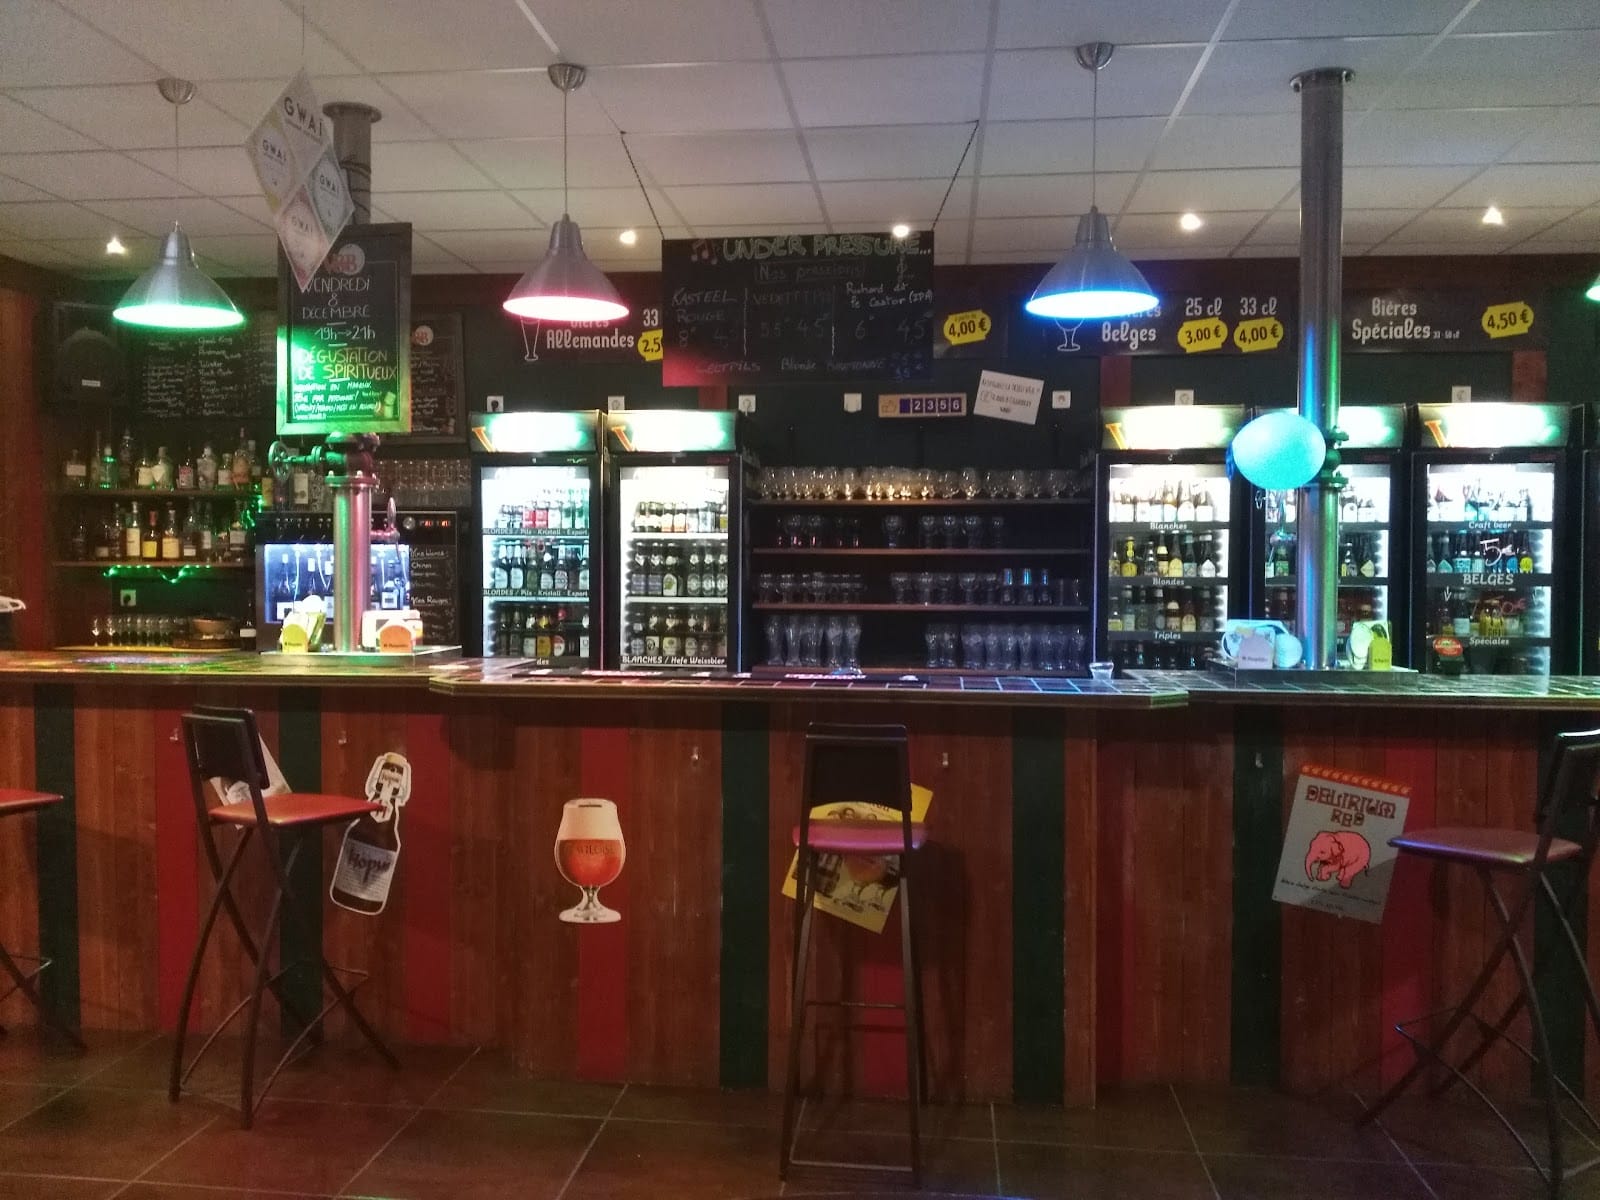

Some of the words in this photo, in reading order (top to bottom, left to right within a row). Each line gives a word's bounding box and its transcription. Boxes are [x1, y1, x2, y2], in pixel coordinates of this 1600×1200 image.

[723, 236, 807, 261] UNDER
[328, 293, 338, 307] 8
[671, 287, 738, 306] KASTEEL
[868, 296, 907, 308] Castor
[1186, 297, 1202, 316] 25
[1207, 296, 1222, 315] cl
[1240, 297, 1256, 316] 33
[1262, 296, 1277, 315] cl
[676, 308, 726, 323] ROUGE
[1372, 296, 1417, 317] Bières
[643, 308, 659, 327] 33
[1487, 312, 1517, 330] 4,50
[1520, 309, 1529, 323] €
[351, 325, 376, 340] 21h
[948, 319, 976, 338] 4,00
[979, 317, 987, 332] €
[1102, 321, 1157, 350] Belges
[1186, 324, 1211, 345] 3,00
[1214, 324, 1222, 338] €
[1239, 326, 1268, 346] 4,00
[1270, 324, 1279, 338] €
[1351, 318, 1431, 344] Spéciales
[546, 327, 635, 349] Allemandes
[322, 362, 397, 381] SPIRITUEUX
[1150, 522, 1188, 533] Blanches
[1468, 521, 1491, 530] Craft
[1493, 521, 1512, 529] beer
[1152, 577, 1185, 586] Blondes
[1463, 573, 1514, 586] BELGES
[1154, 632, 1181, 643] Triples
[622, 655, 663, 664] BLANCHES
[671, 656, 687, 665] Hefe
[690, 656, 725, 664] Weissbier
[1306, 785, 1395, 819] DELIRIUM
